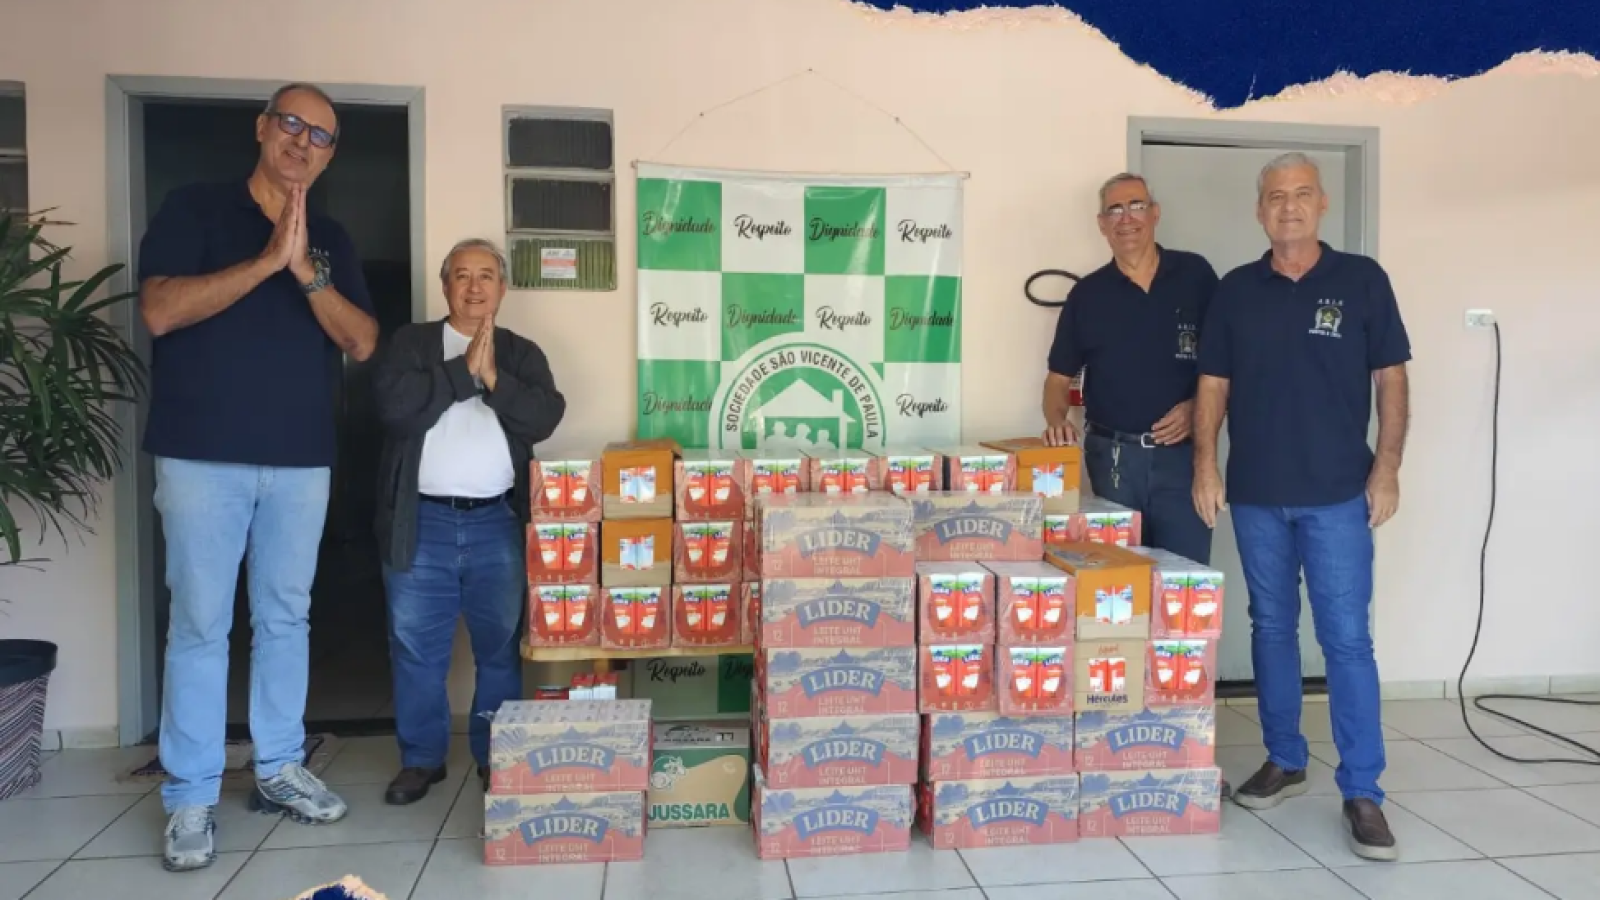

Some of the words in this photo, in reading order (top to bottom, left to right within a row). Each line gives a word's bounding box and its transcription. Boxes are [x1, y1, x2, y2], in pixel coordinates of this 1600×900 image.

[734, 214, 792, 240] Respeito
[897, 219, 953, 243] Respeito
[650, 302, 708, 328] Respeito
[815, 305, 871, 331] Respeito
[726, 363, 769, 432] SOCIEDADE
[769, 351, 795, 369] SÃO
[800, 350, 851, 380] VICENTE
[848, 375, 866, 395] DE
[859, 395, 879, 438] PAULA
[895, 394, 949, 418] Respeito
[942, 518, 1004, 538] LIDER
[804, 529, 870, 550] LIDER
[804, 600, 870, 620] LIDER
[646, 658, 706, 684] Respeito
[809, 669, 876, 692] LIDER
[972, 733, 1035, 754] LIDER
[1115, 726, 1177, 746] LIDER
[536, 747, 606, 768] LIDER
[809, 740, 876, 763] LIDER
[649, 803, 730, 820] JUSSARA
[975, 801, 1040, 822] LIDER
[1118, 792, 1180, 812] LIDER
[529, 816, 600, 839] LIDER
[803, 810, 870, 832] LIDER
